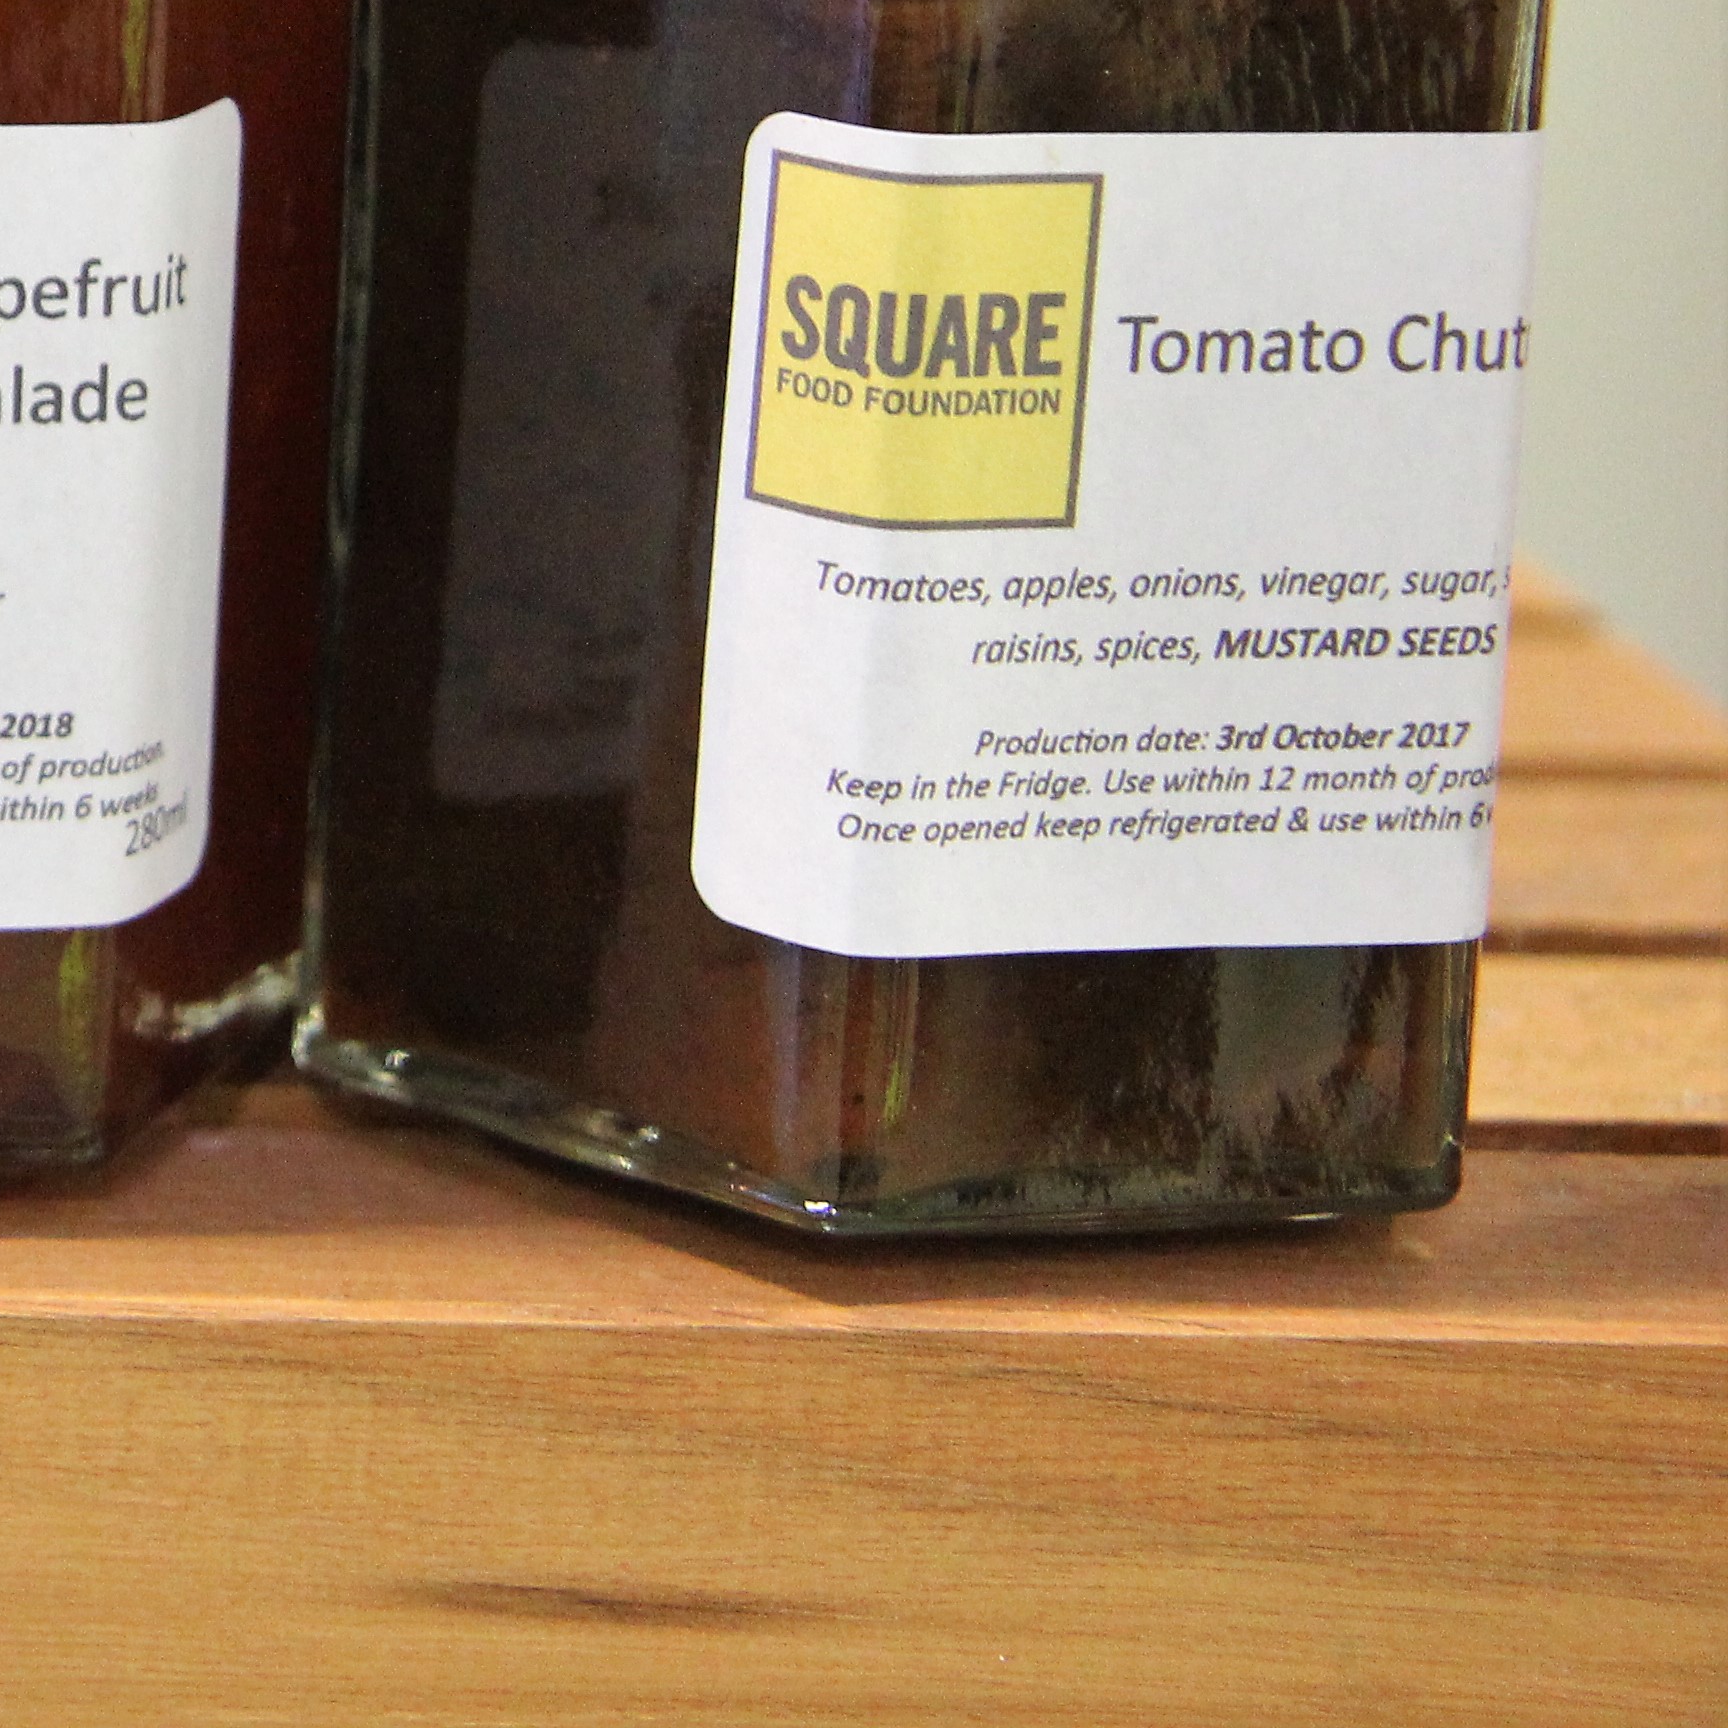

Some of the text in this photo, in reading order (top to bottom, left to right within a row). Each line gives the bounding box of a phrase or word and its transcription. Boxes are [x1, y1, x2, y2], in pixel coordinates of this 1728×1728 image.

[781, 274, 1067, 378] SQUARE
[1117, 311, 1530, 373] Tomato Chut
[776, 367, 1062, 417] FOOD FOUNDATION
[817, 560, 991, 606] Tomatoes,
[1004, 568, 1117, 607] apples,
[1129, 567, 1245, 602] onions,
[1261, 566, 1389, 603] vinegar,
[1401, 569, 1496, 602] sugar,
[972, 624, 1497, 668] raisins, spices, MUSTARD SEEDS
[975, 722, 1470, 756] Production date: 3rd October 2017
[1, 752, 34, 785] of
[827, 768, 902, 804] Keep
[911, 775, 935, 800] in
[946, 773, 990, 799] the
[998, 770, 1091, 800] Fridge.
[1104, 768, 1154, 794] Use
[1163, 767, 1249, 793] within
[1260, 767, 1294, 791] 12
[1303, 764, 1396, 791] month
[1406, 763, 1439, 795] of
[75, 793, 92, 820] 6
[837, 813, 915, 842] Once
[923, 812, 1028, 846] opened
[1035, 811, 1101, 841] keep
[1109, 807, 1280, 840] refrigerated
[1288, 806, 1309, 832] &
[1319, 811, 1367, 832] use
[1377, 805, 1462, 831] within
[1470, 802, 1483, 828] 6
